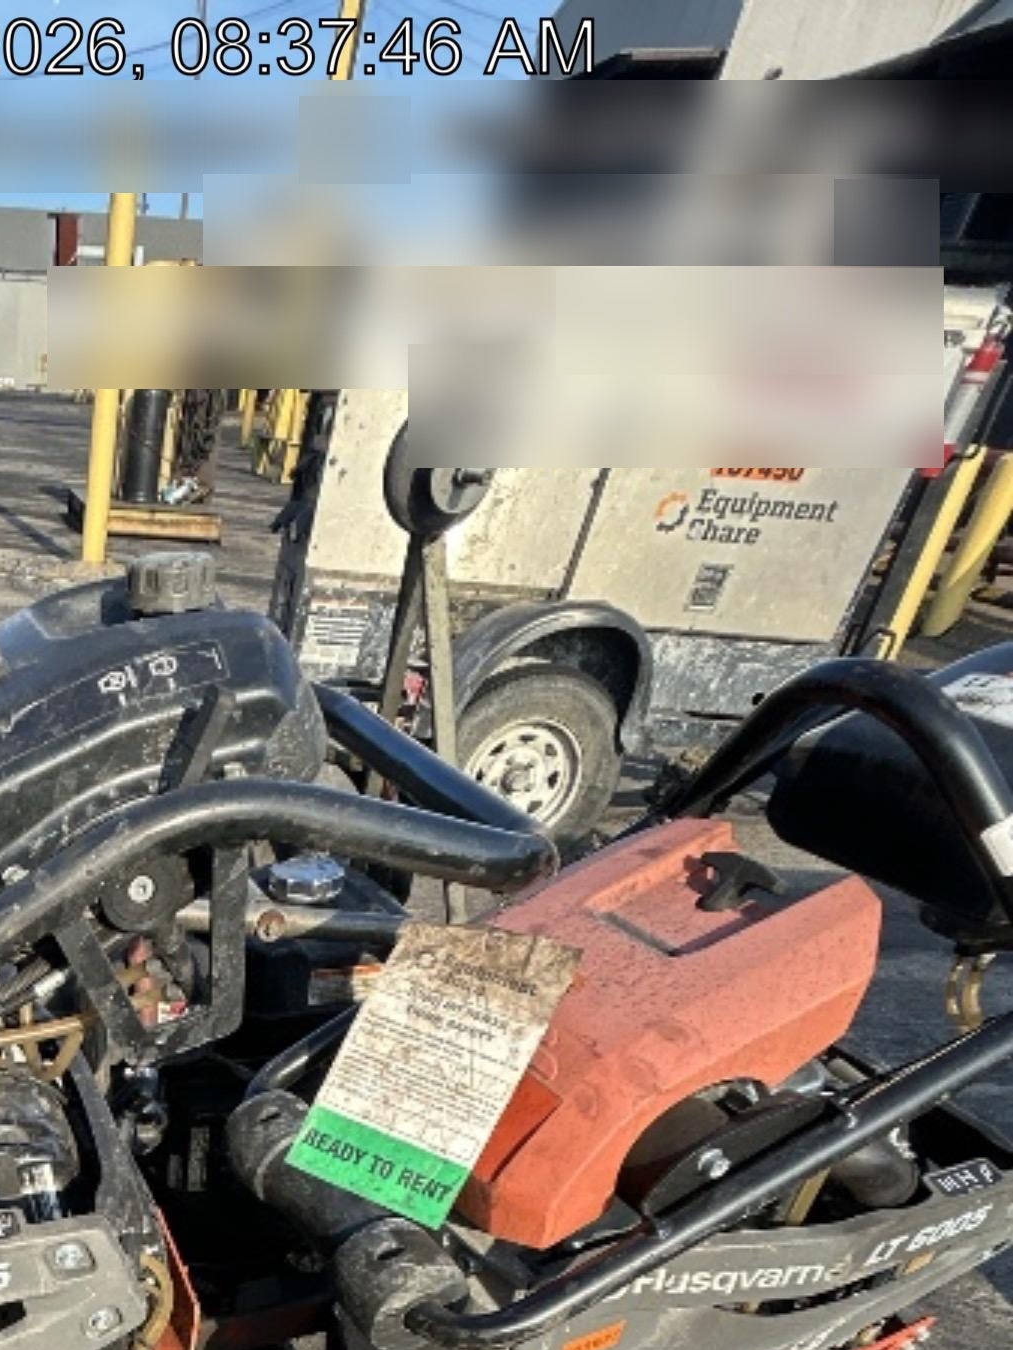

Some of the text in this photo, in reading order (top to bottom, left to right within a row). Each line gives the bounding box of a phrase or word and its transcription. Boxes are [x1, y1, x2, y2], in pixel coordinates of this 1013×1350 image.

[695, 488, 839, 523] Equipment
[686, 517, 762, 545] Share
[301, 1127, 453, 1205] READY TO RENT
[864, 1203, 994, 1266] LT 6005
[633, 1253, 854, 1296] Husqvarna
